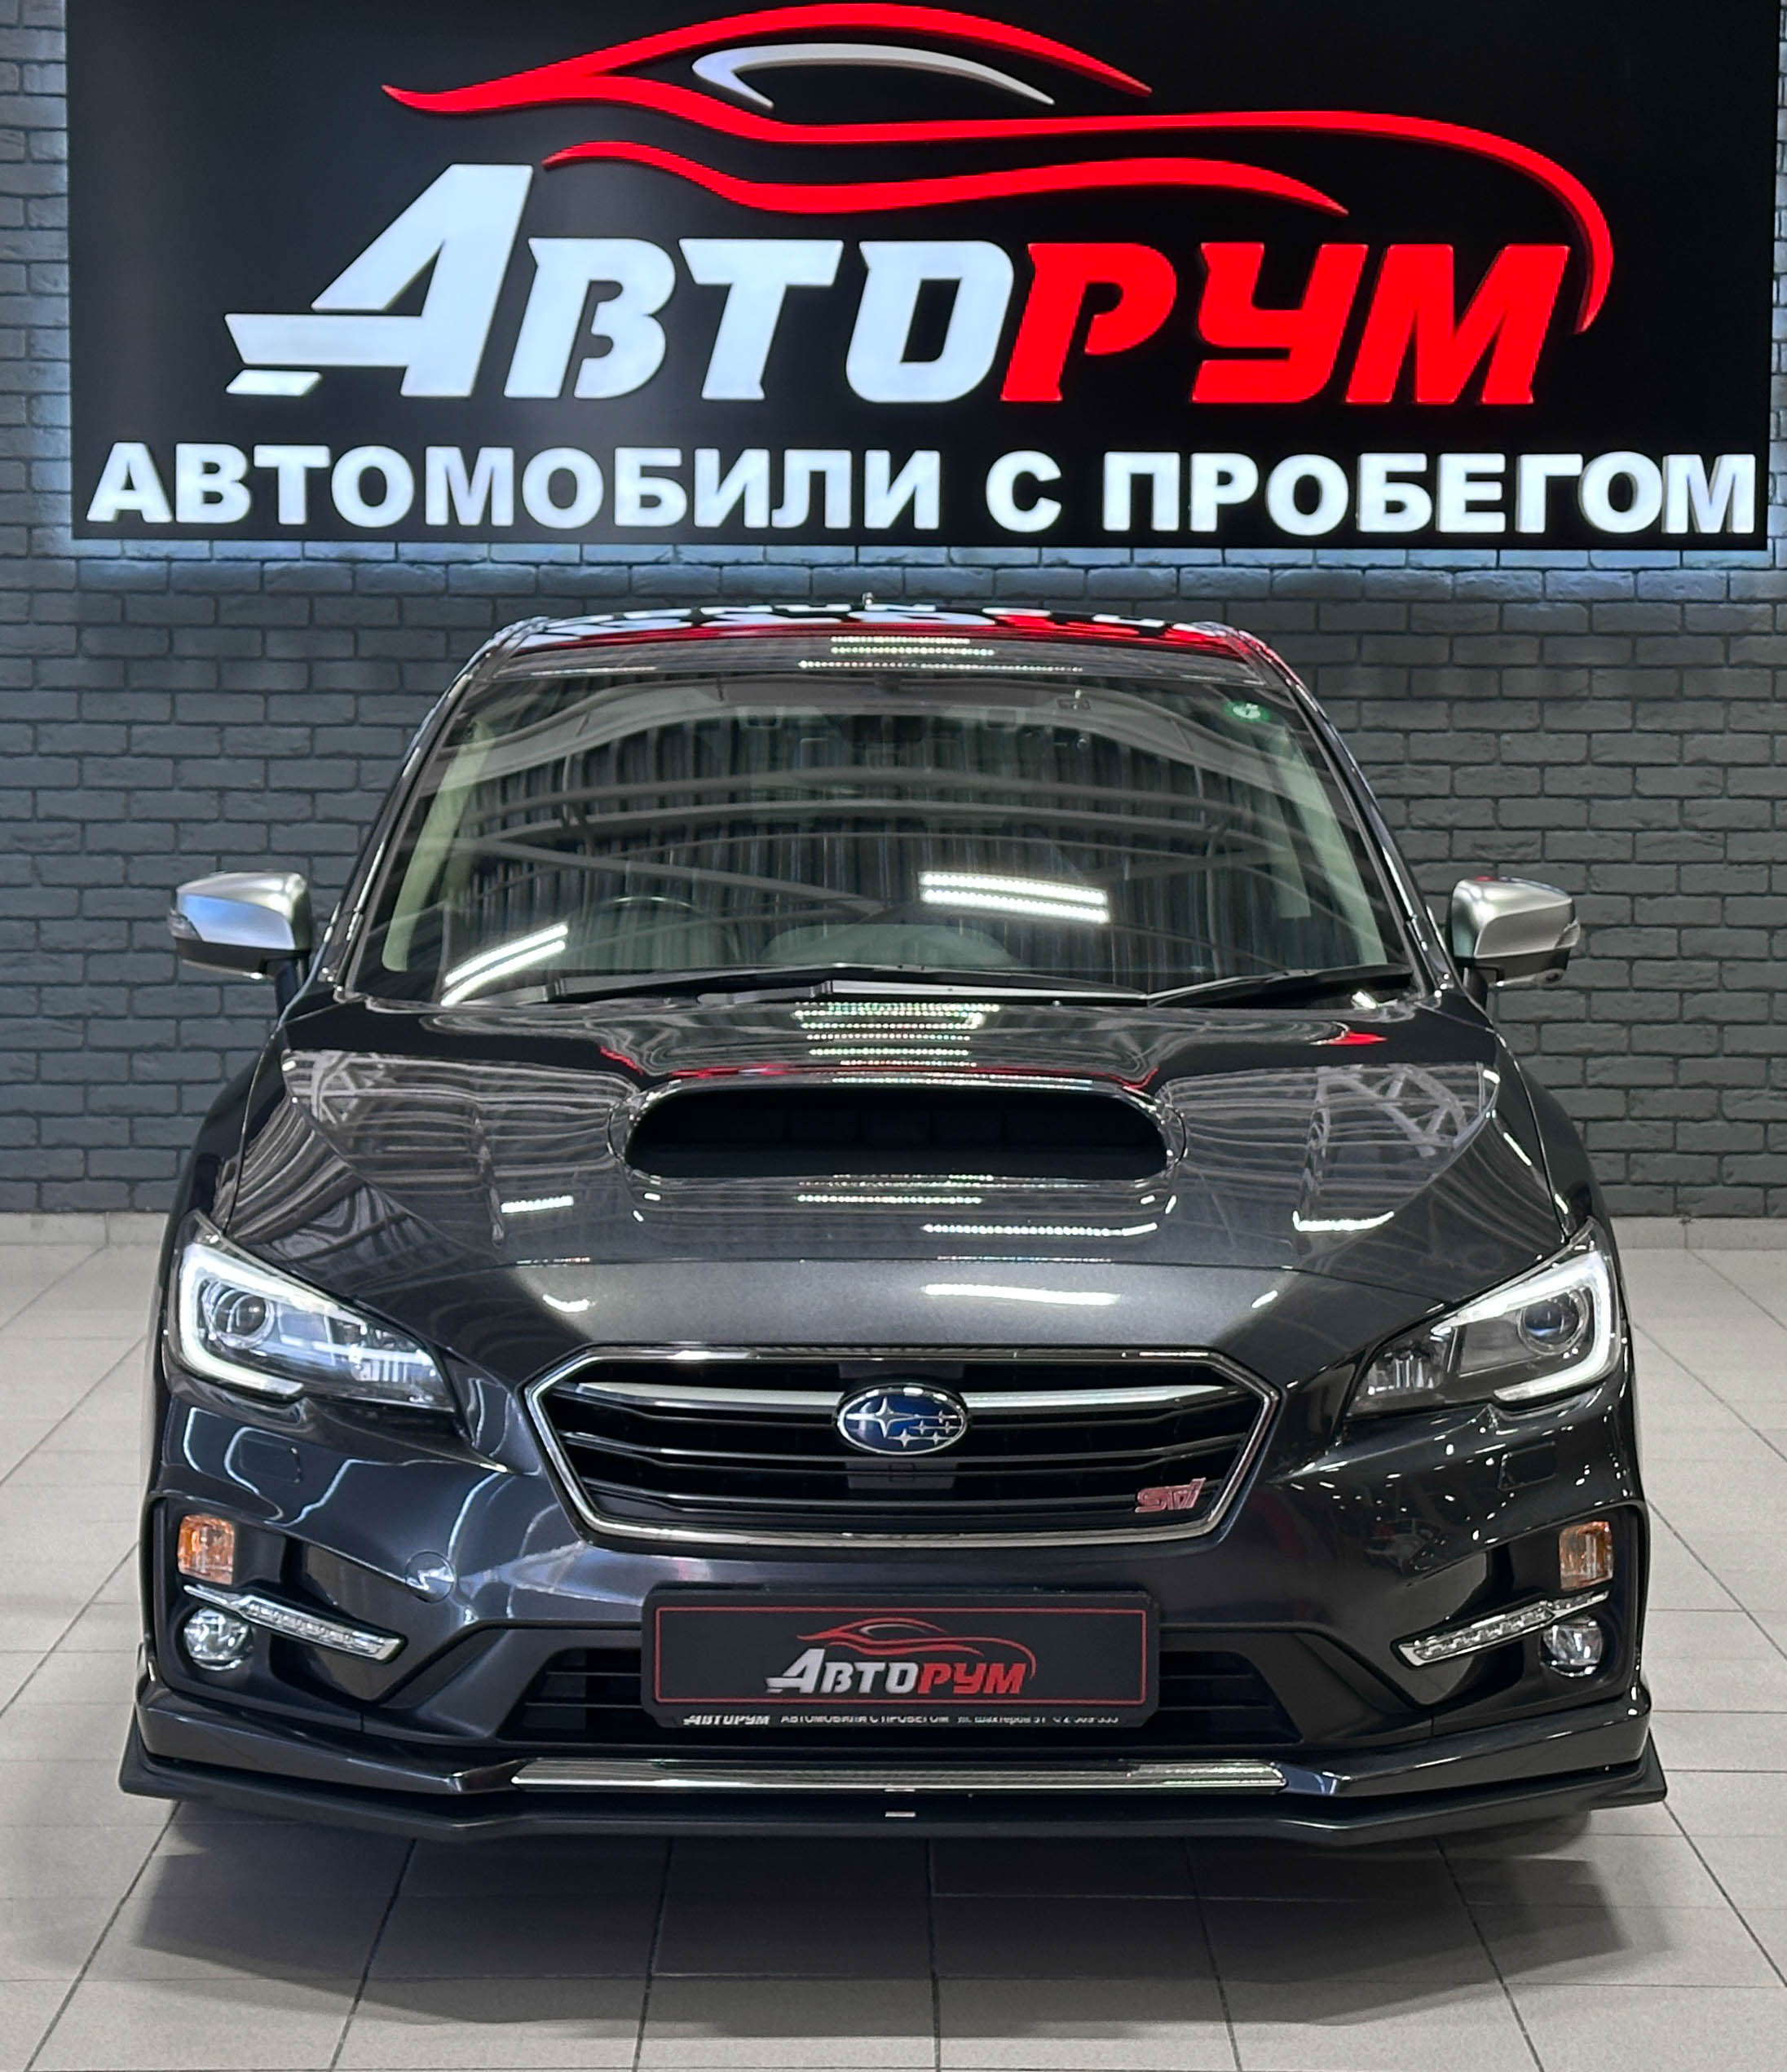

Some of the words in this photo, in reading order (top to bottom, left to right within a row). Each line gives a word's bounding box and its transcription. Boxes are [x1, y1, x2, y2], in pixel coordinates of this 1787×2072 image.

[224, 164, 1572, 405] АВТОРУМ
[86, 442, 942, 530] АВТОМОБИЛИ
[986, 450, 1062, 533] С
[1103, 450, 1757, 536] ПРОБЕГОМ
[765, 1648, 1026, 1694] АВТОРУМ
